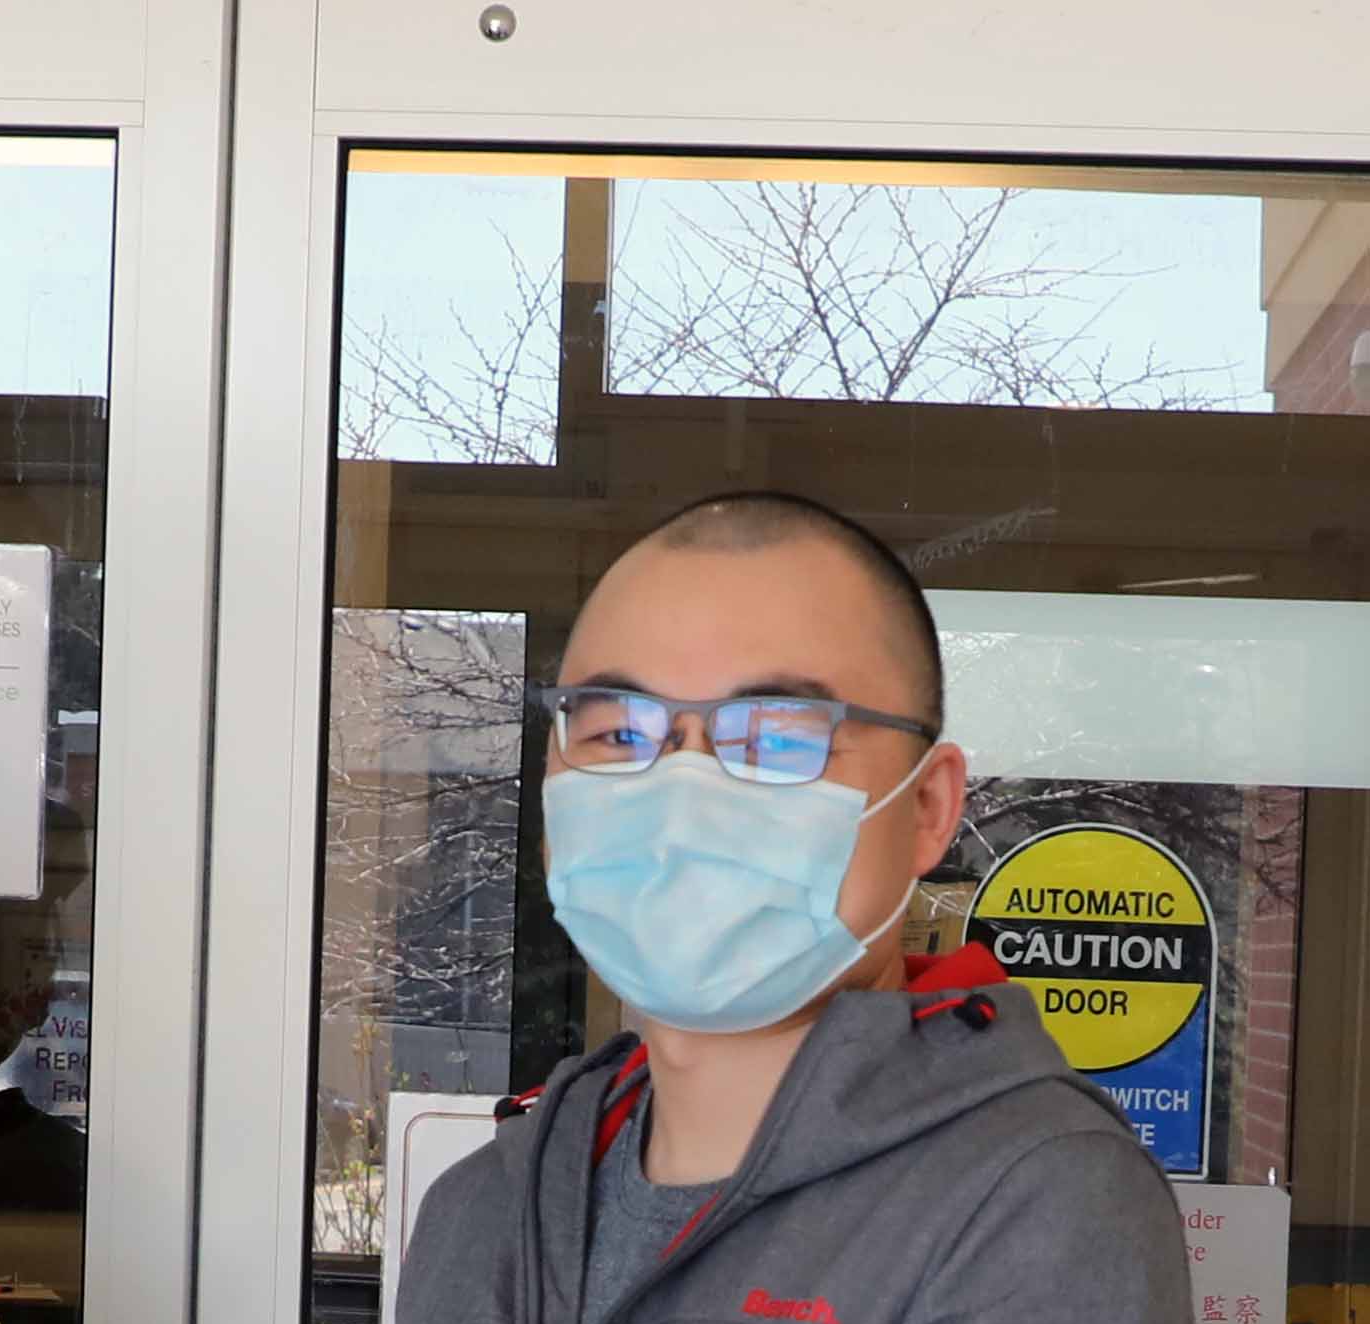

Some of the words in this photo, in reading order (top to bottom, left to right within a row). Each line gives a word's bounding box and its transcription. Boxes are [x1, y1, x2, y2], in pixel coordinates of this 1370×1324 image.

[1005, 888, 1174, 918] AUTOMATIC
[993, 929, 1183, 970] CAUTION
[1044, 988, 1128, 1016] DOOR
